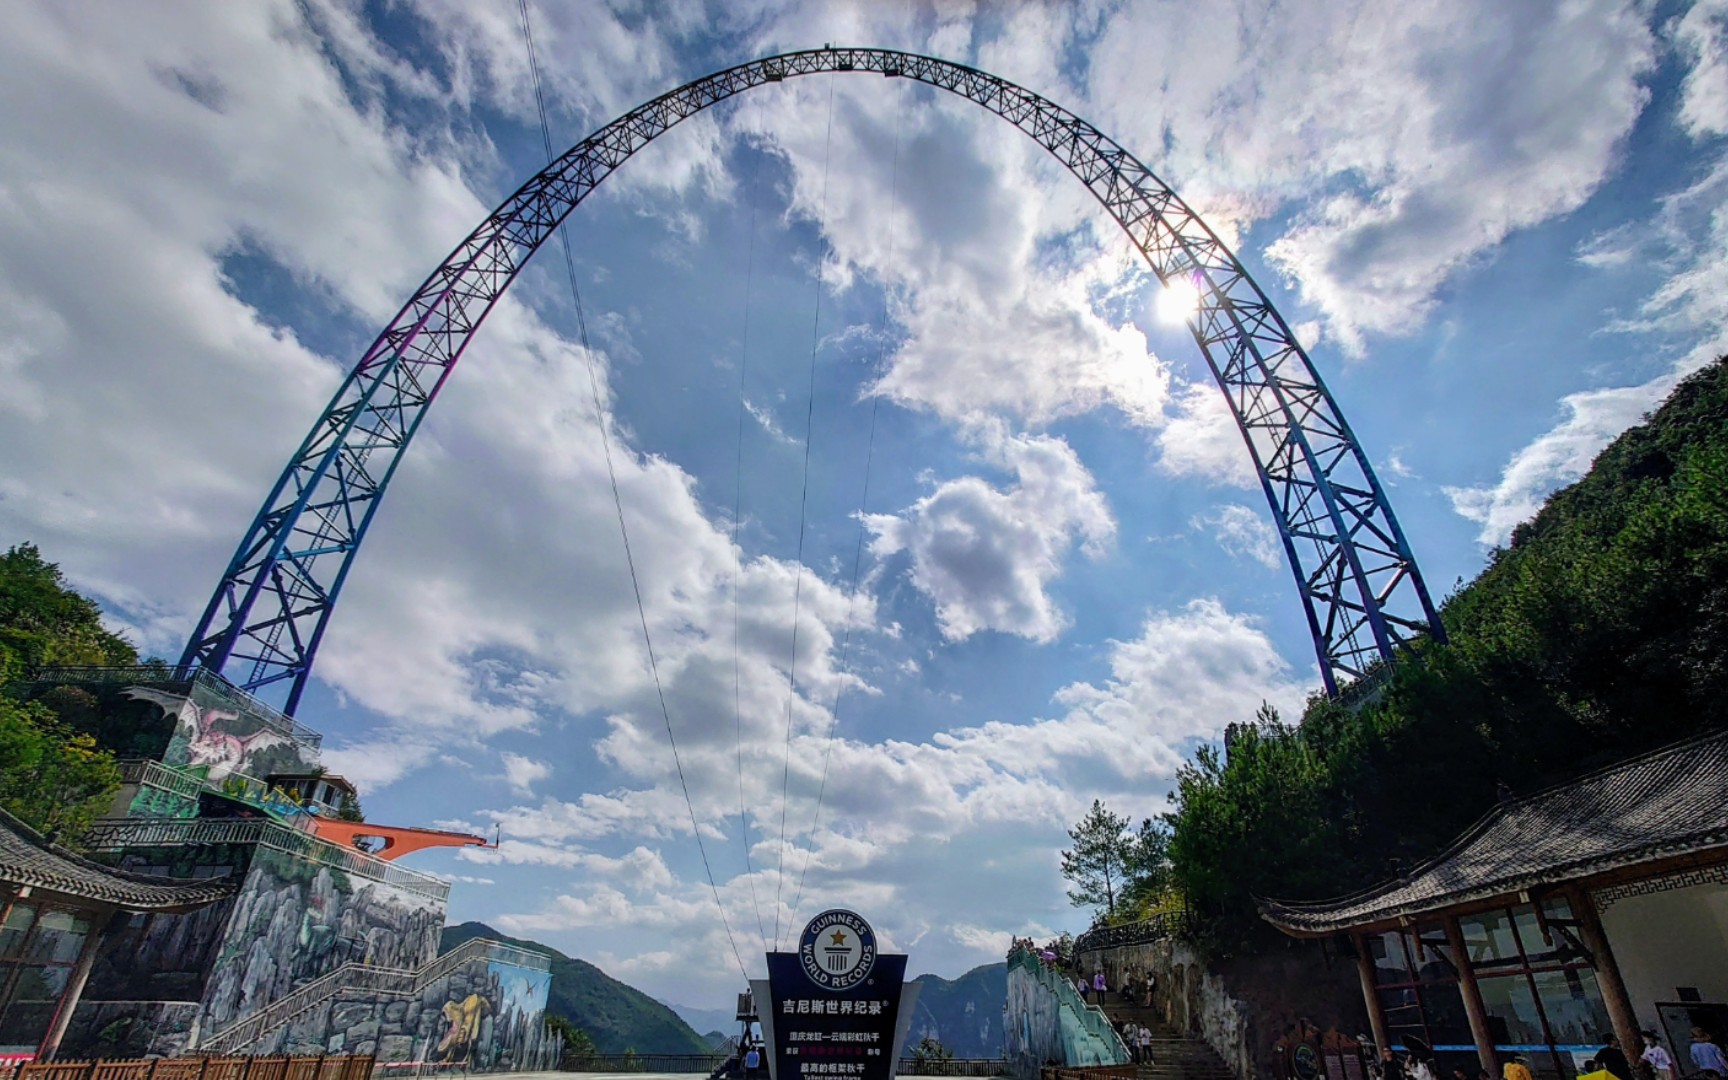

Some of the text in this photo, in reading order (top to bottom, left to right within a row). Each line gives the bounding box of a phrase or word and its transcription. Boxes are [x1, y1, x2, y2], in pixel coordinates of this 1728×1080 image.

[811, 914, 867, 935] GUINNESS
[803, 944, 873, 987] WORLD RECORDS
[782, 999, 881, 1015] 吉尼斯世界纪录
